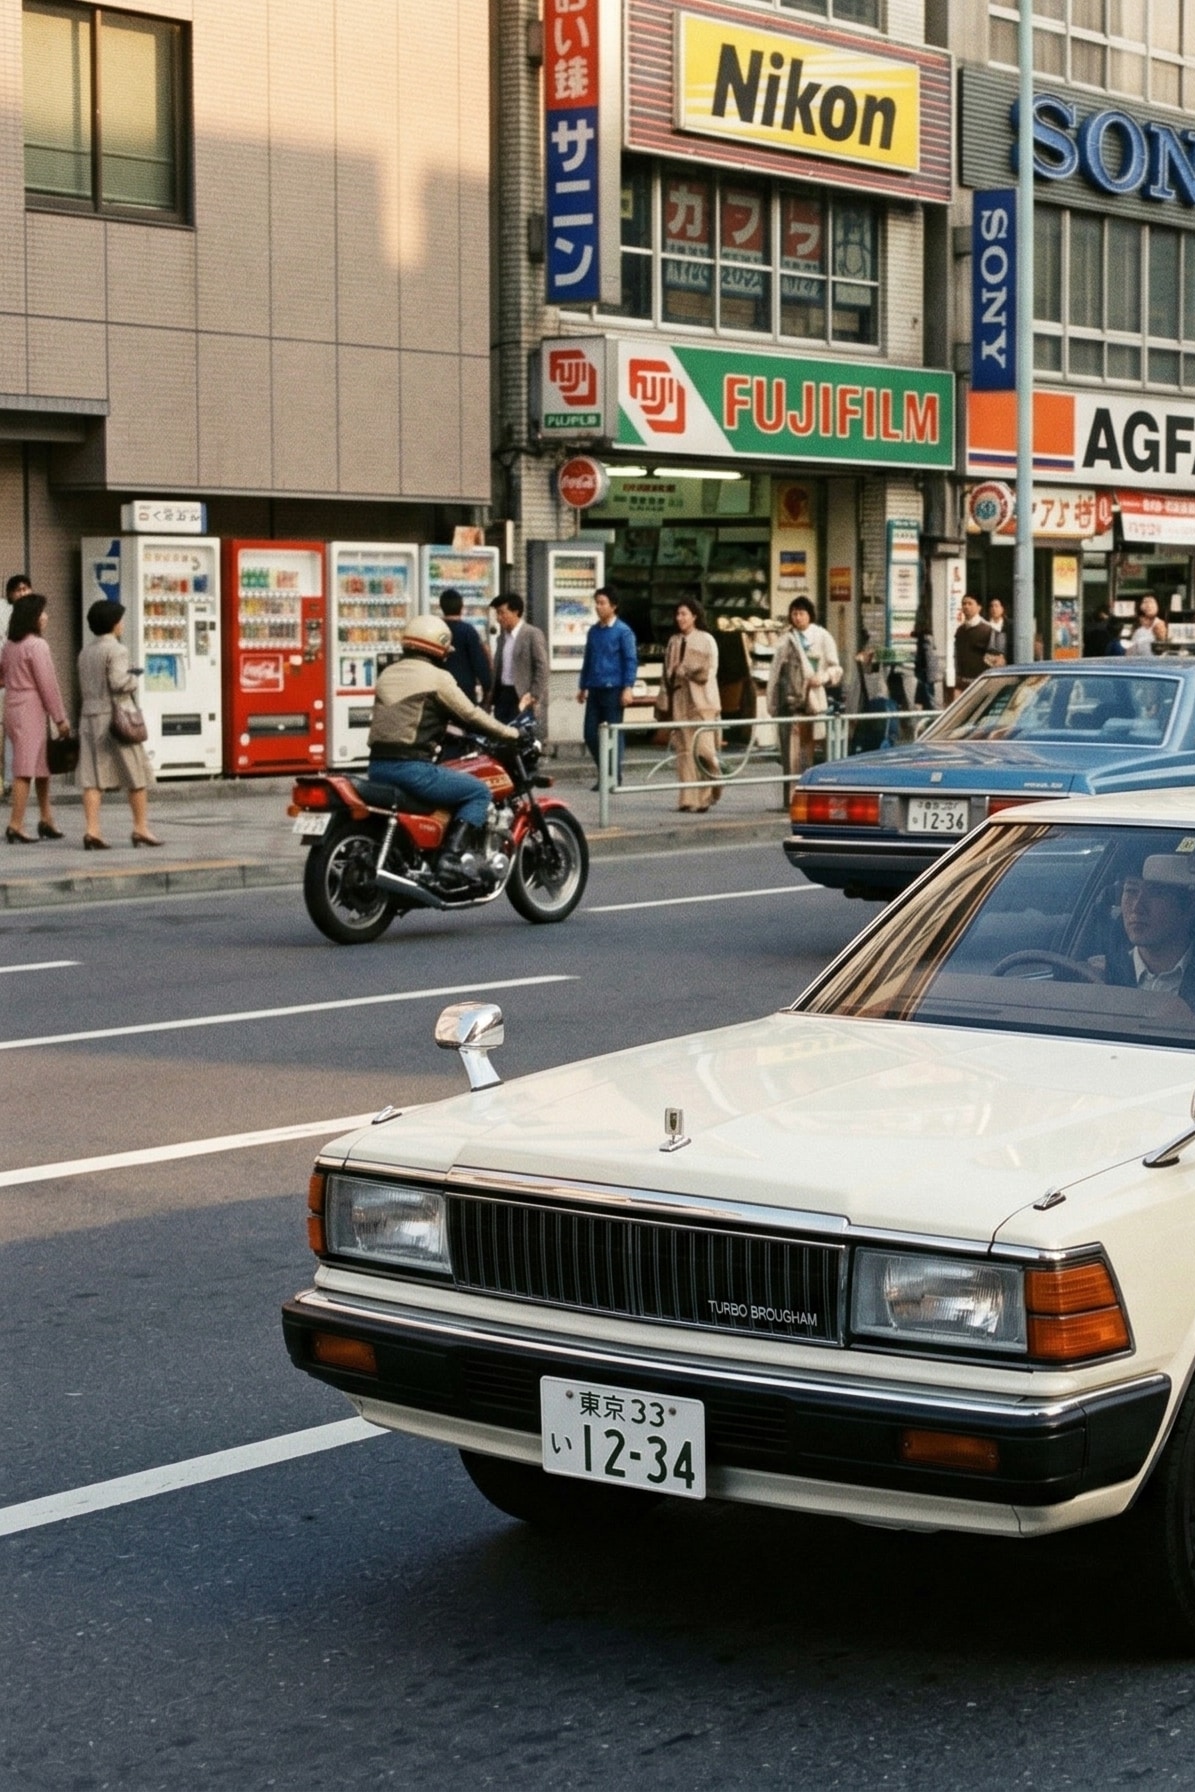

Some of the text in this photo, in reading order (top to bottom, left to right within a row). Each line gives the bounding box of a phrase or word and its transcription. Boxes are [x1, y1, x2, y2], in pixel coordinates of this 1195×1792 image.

[711, 43, 897, 151] Nikon
[980, 208, 1009, 369] SONY
[723, 375, 940, 444] FUJIFILM
[708, 1299, 818, 1326] TURBO BROUGHAM
[579, 1391, 665, 1428] 東京 33
[551, 1424, 695, 1490] い 12-34
